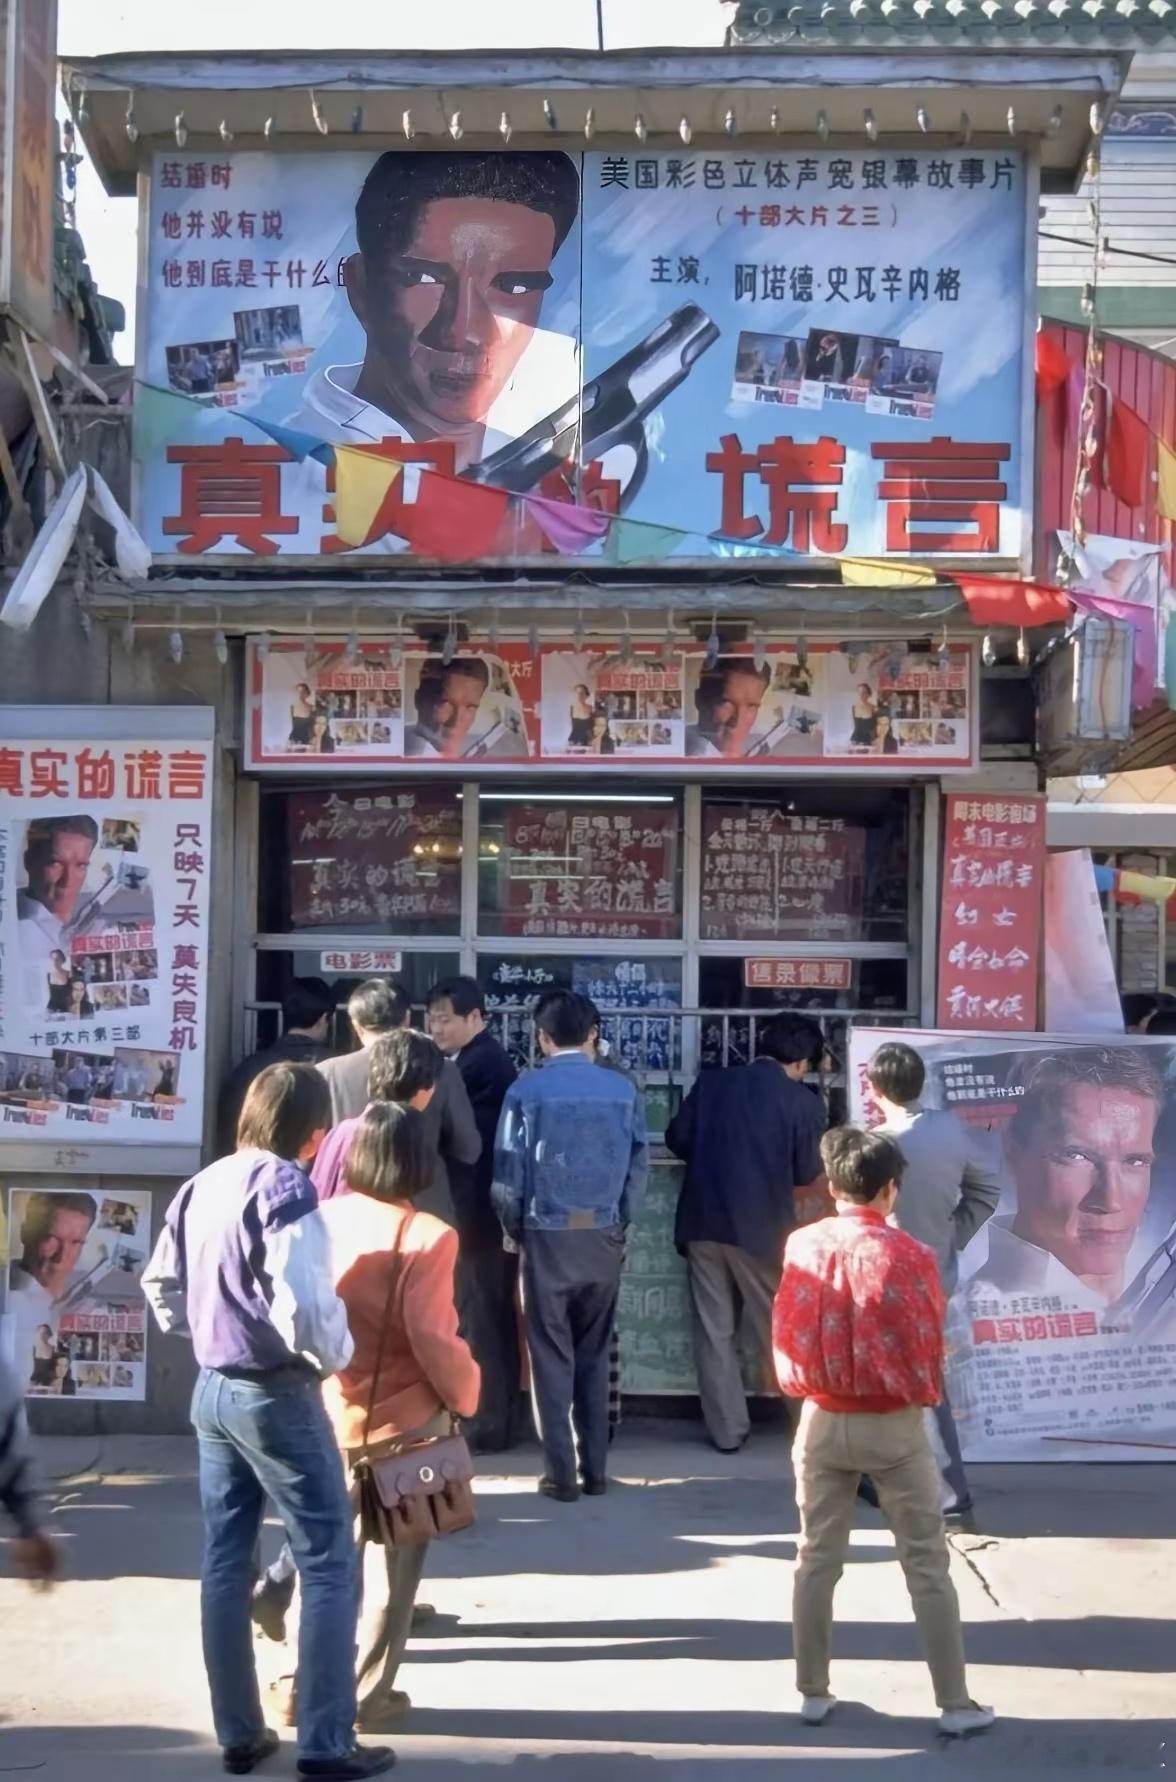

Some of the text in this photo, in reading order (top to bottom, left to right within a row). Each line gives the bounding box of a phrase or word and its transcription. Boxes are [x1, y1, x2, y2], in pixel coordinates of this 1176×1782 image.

[600, 157, 1016, 191] 美国彩色立体声宽银幕故事片
[161, 210, 284, 240] 他并没有说
[502, 660, 533, 678] 大厅
[326, 952, 396, 969] 电影票
